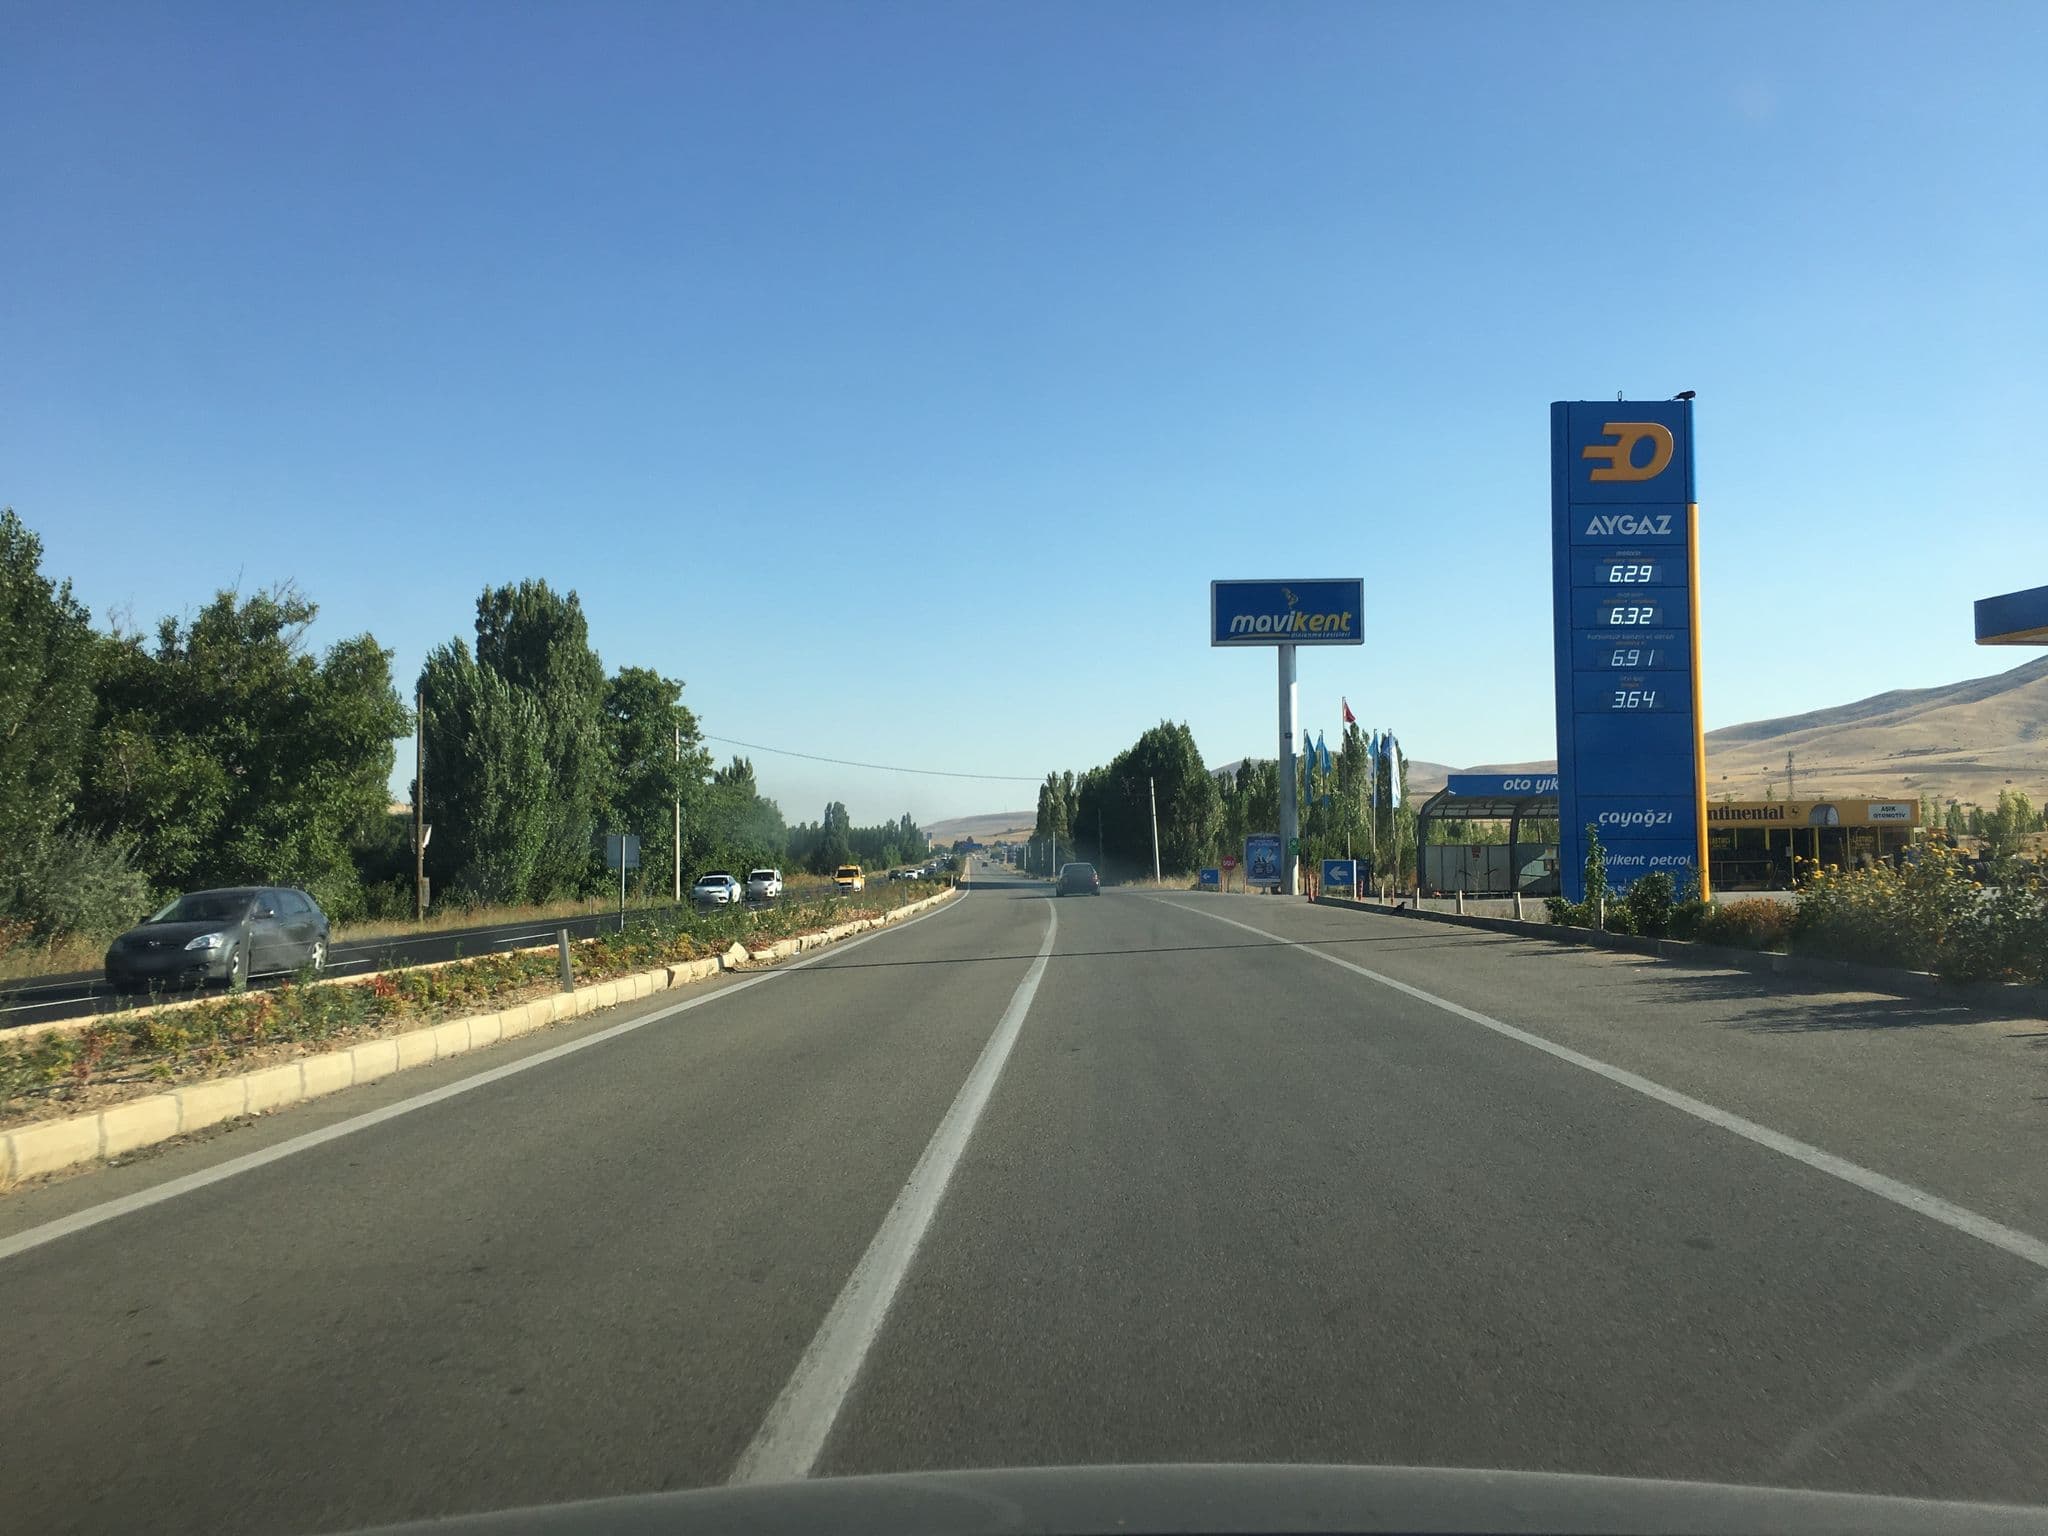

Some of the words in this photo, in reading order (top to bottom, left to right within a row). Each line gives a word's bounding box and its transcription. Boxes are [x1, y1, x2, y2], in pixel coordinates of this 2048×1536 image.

[1585, 514, 1672, 535] AYGAZ
[1609, 565, 1653, 583] 6.29
[1229, 610, 1352, 633] mavikent
[1610, 607, 1654, 625] 6.32
[1611, 649, 1655, 667] 6.91
[1612, 691, 1656, 709] 3.64
[1503, 778, 1531, 791] oto
[1598, 809, 1673, 828] çayağzı
[1649, 855, 1691, 867] petrol
